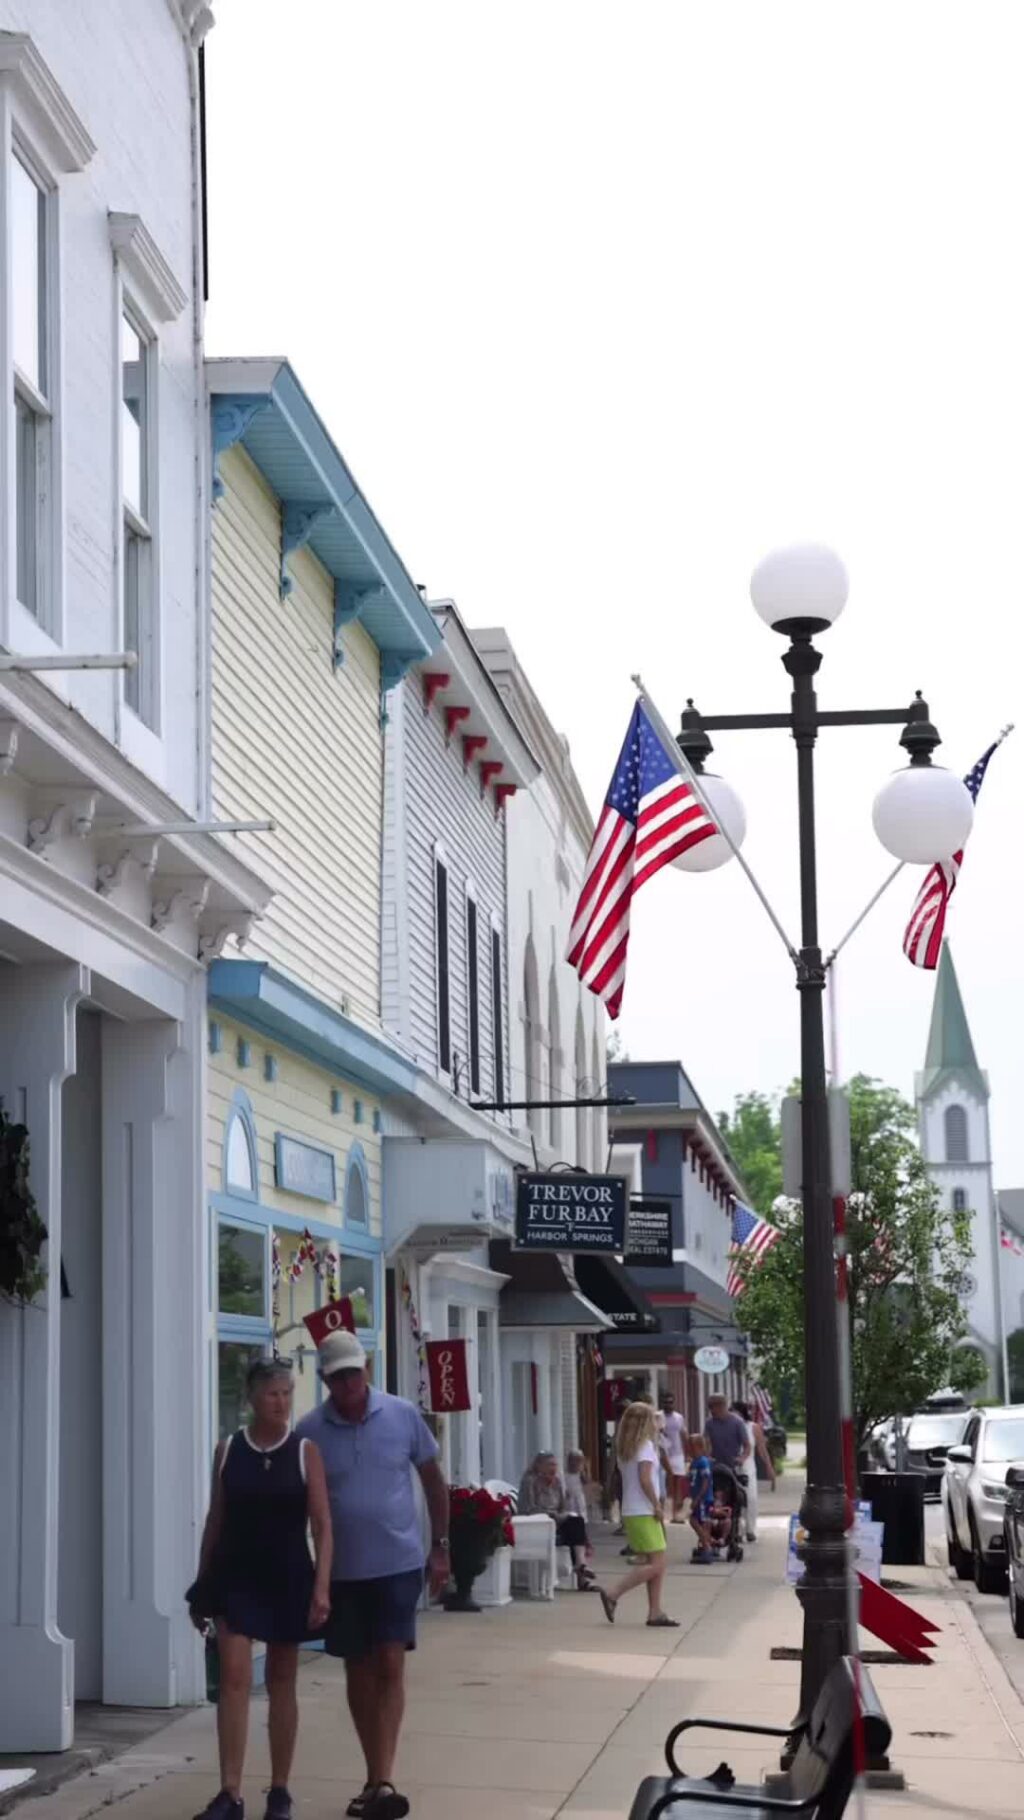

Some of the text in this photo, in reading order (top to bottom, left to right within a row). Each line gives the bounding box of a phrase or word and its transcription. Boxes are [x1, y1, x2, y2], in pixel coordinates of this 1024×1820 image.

[528, 1184, 614, 1202] TREVOR
[528, 1204, 614, 1222] FURBAY
[527, 1231, 614, 1243] HARBOR SPRINGS
[437, 1350, 456, 1406] OPEN
